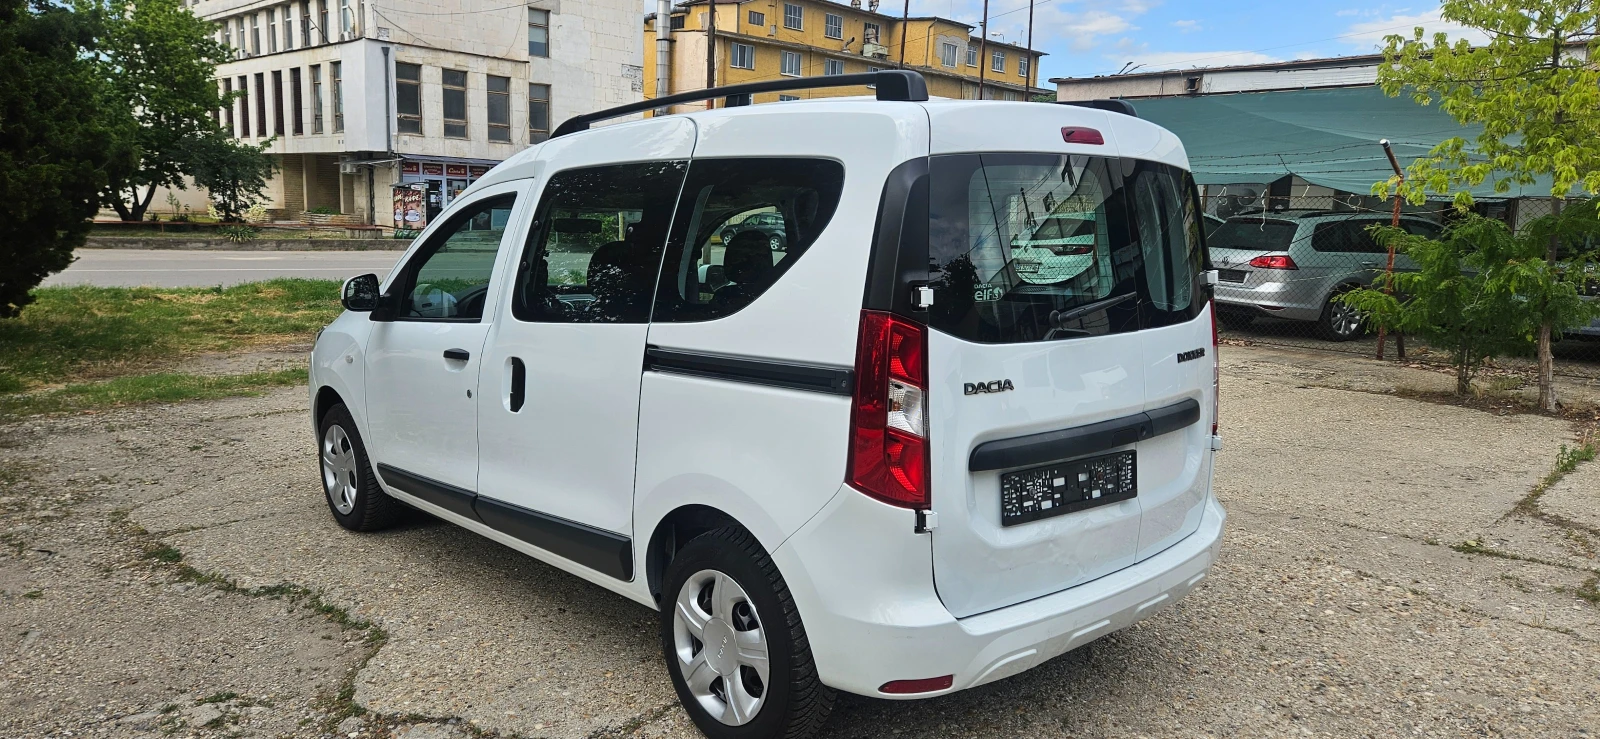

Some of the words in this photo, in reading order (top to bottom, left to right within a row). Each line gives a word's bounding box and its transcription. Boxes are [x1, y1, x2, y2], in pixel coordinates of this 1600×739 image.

[974, 289, 993, 301] elf
[1177, 347, 1205, 363] DOKKER
[964, 379, 1014, 395] DACIA
